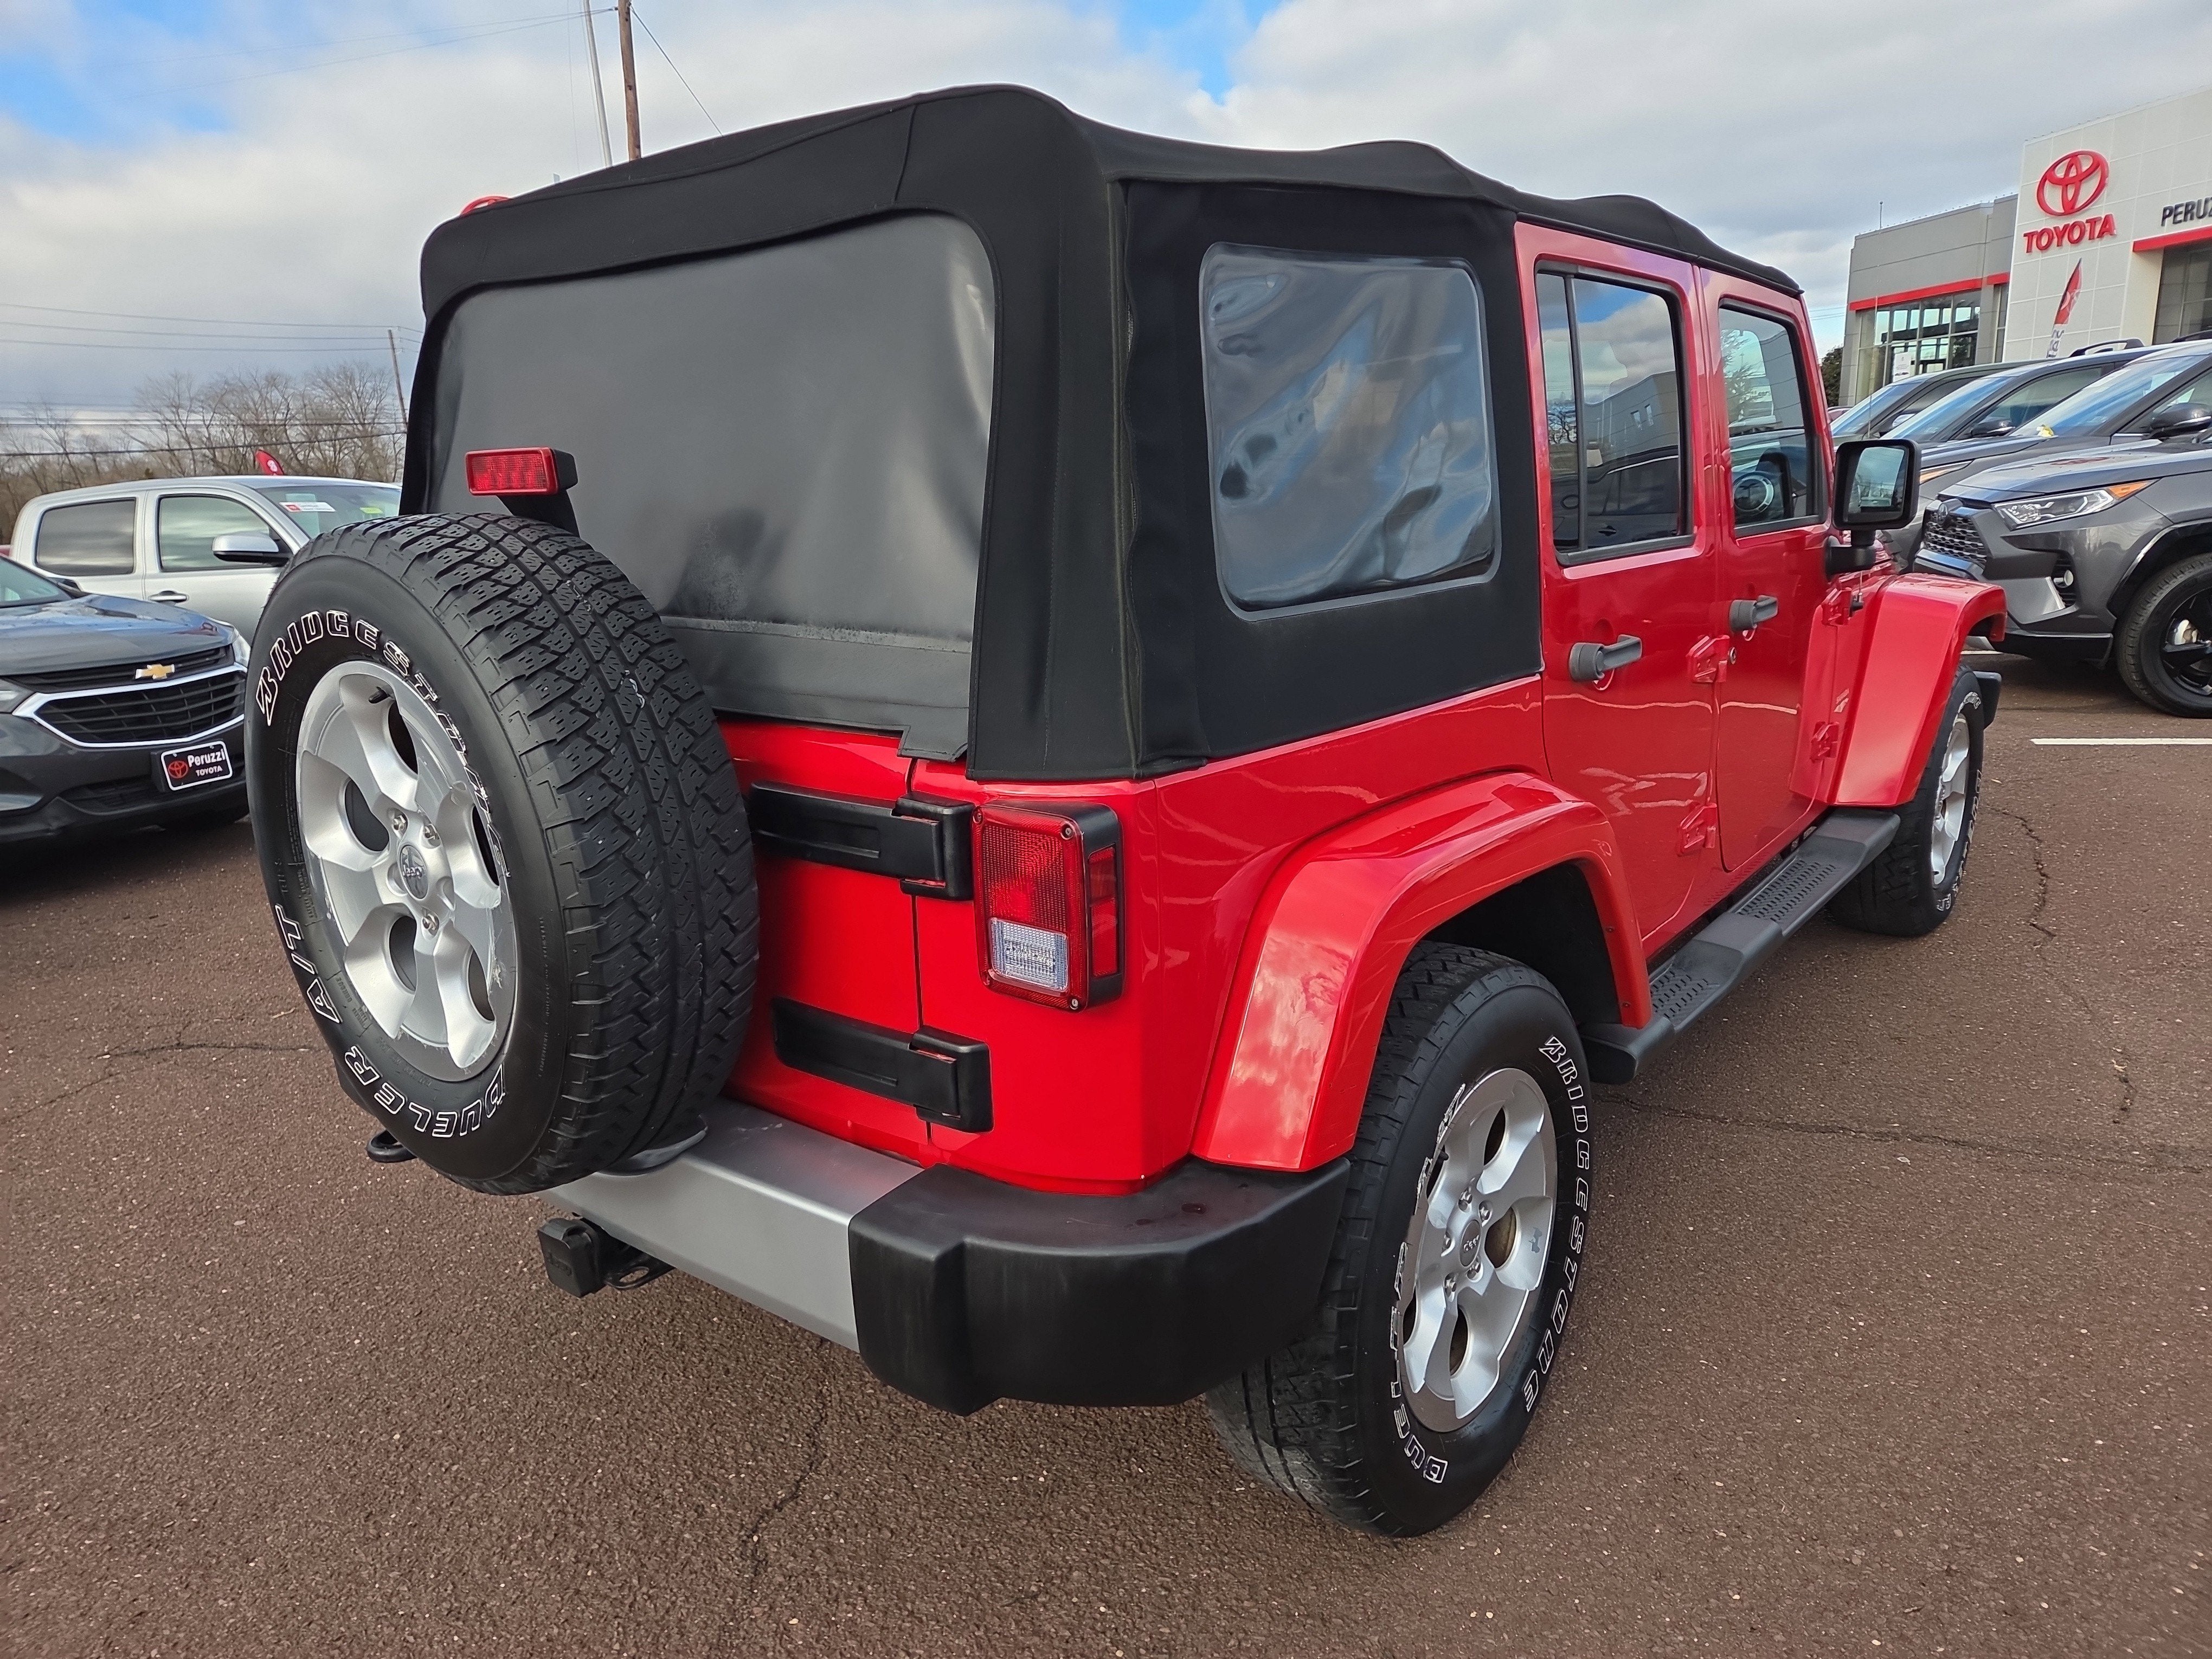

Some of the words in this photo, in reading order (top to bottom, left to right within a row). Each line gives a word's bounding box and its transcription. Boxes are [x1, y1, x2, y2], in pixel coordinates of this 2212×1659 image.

[2023, 213, 2116, 253] TOYOTA
[187, 748, 226, 768] Peruzzi
[195, 765, 223, 777] TOYOTA
[275, 903, 342, 1024] A/T
[344, 1045, 506, 1138] DUELER
[1522, 1036, 1590, 1412] BRIDGESTONE
